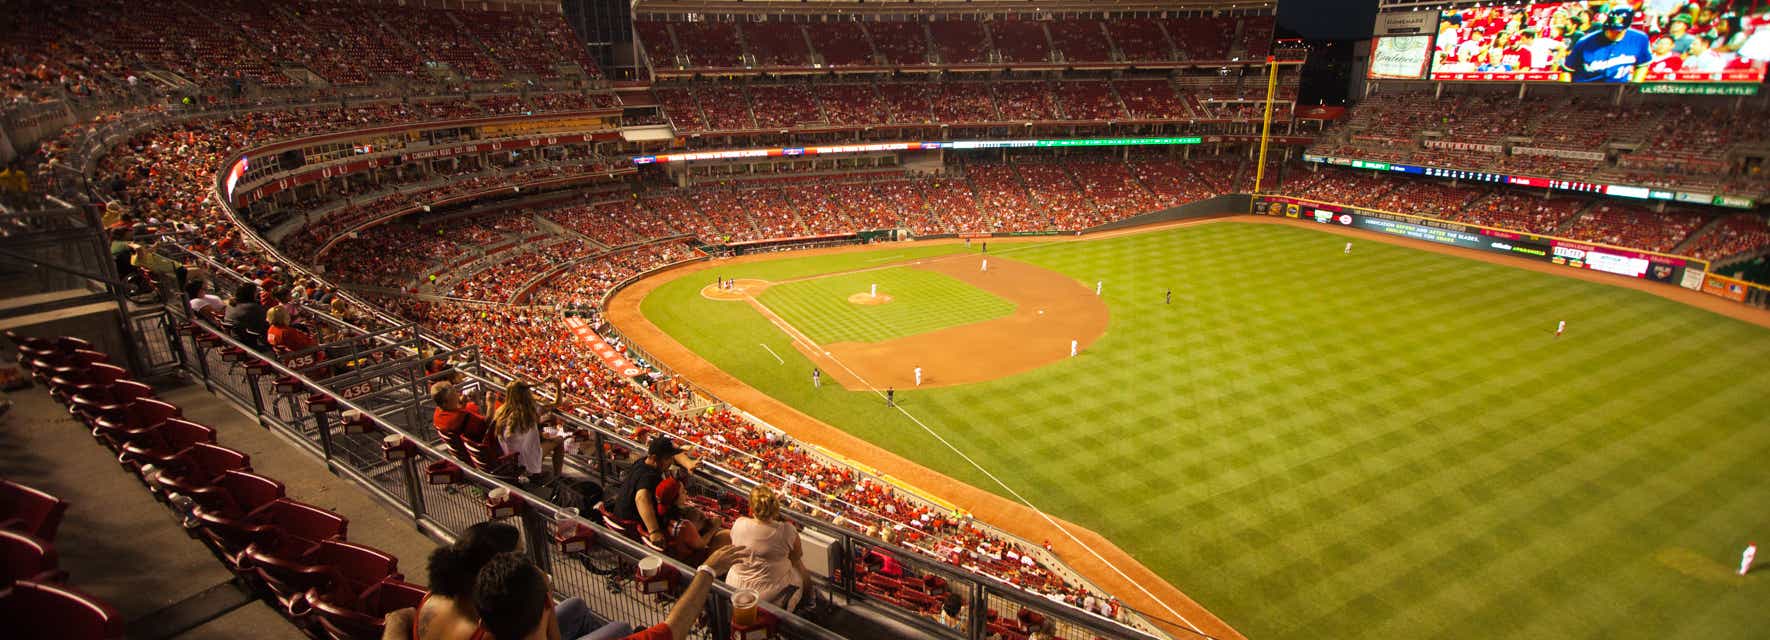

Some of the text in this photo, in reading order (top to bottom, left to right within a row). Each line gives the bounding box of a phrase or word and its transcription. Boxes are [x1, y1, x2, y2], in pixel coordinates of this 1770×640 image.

[1706, 86, 1753, 95] SHUTTLE
[412, 149, 439, 160] CINCINNATI
[288, 354, 314, 369] 435
[343, 382, 371, 399] 436
